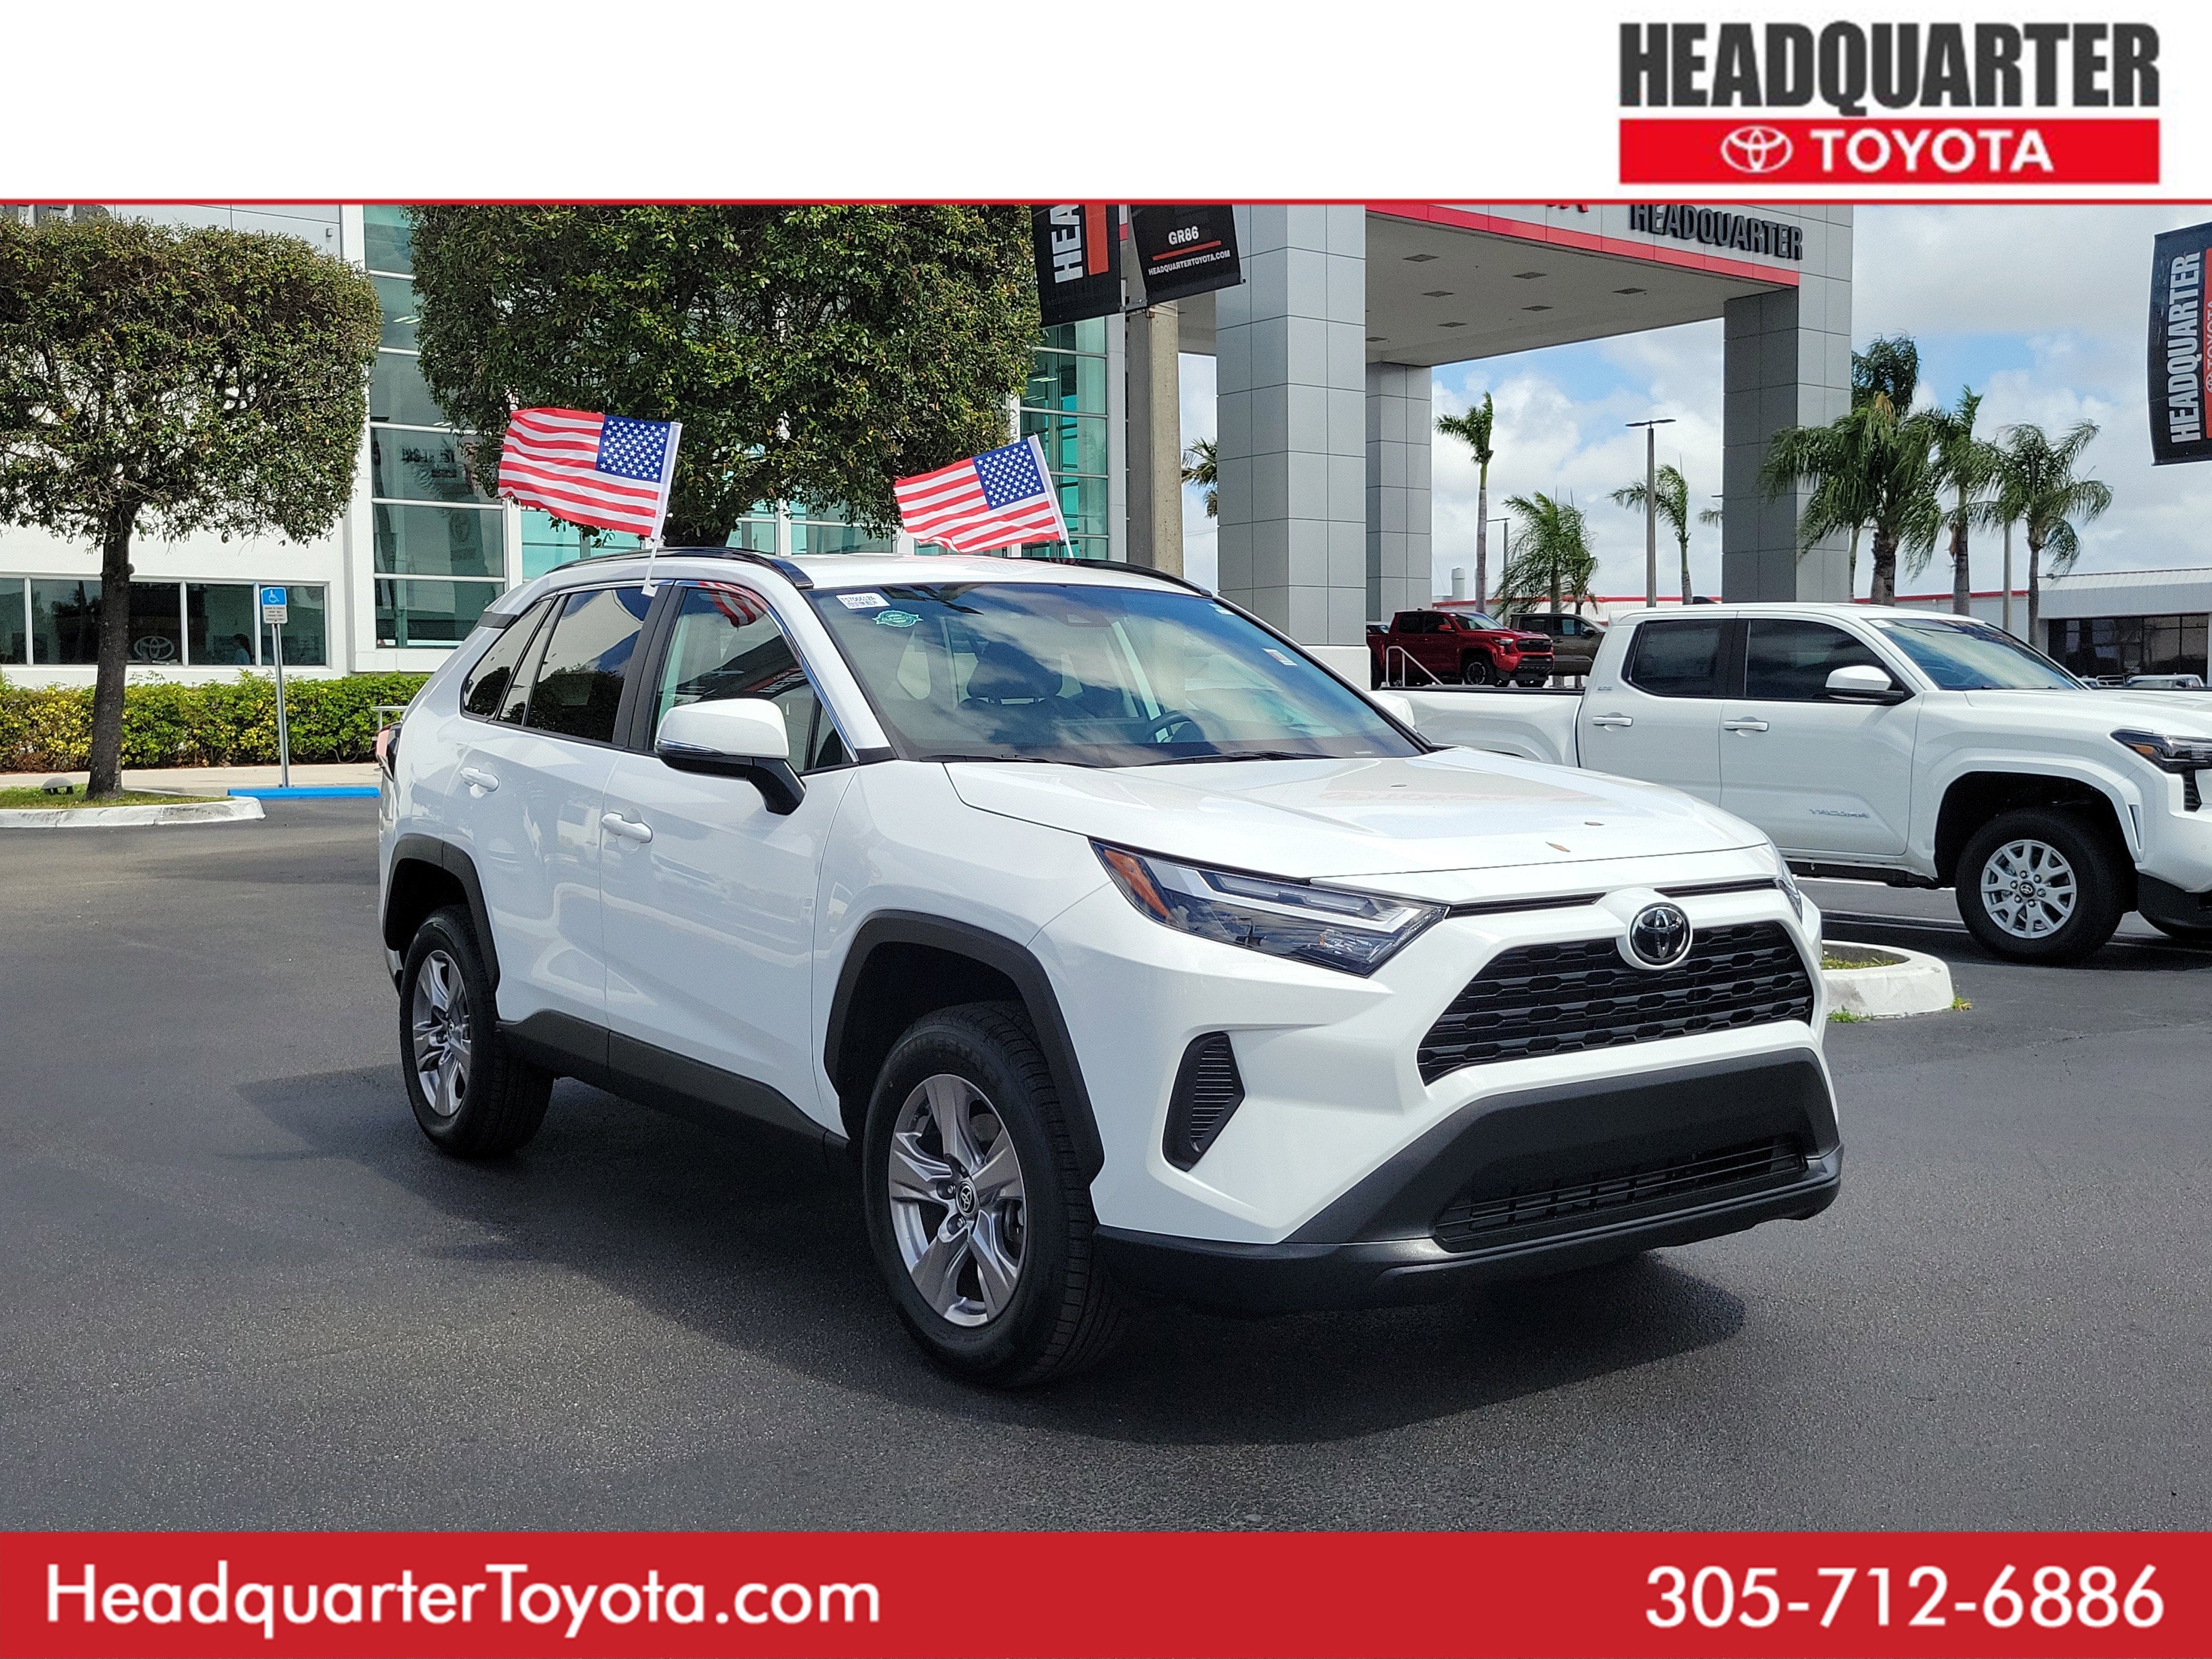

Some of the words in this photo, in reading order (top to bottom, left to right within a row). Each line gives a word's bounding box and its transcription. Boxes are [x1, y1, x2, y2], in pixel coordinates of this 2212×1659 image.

[1168, 225, 1199, 245] GR86
[1629, 204, 1803, 261] HEADQUARTER
[1148, 250, 1231, 275] HEADQUARTERTOYOTA.COM
[2167, 251, 2203, 443] HEADQUARTER
